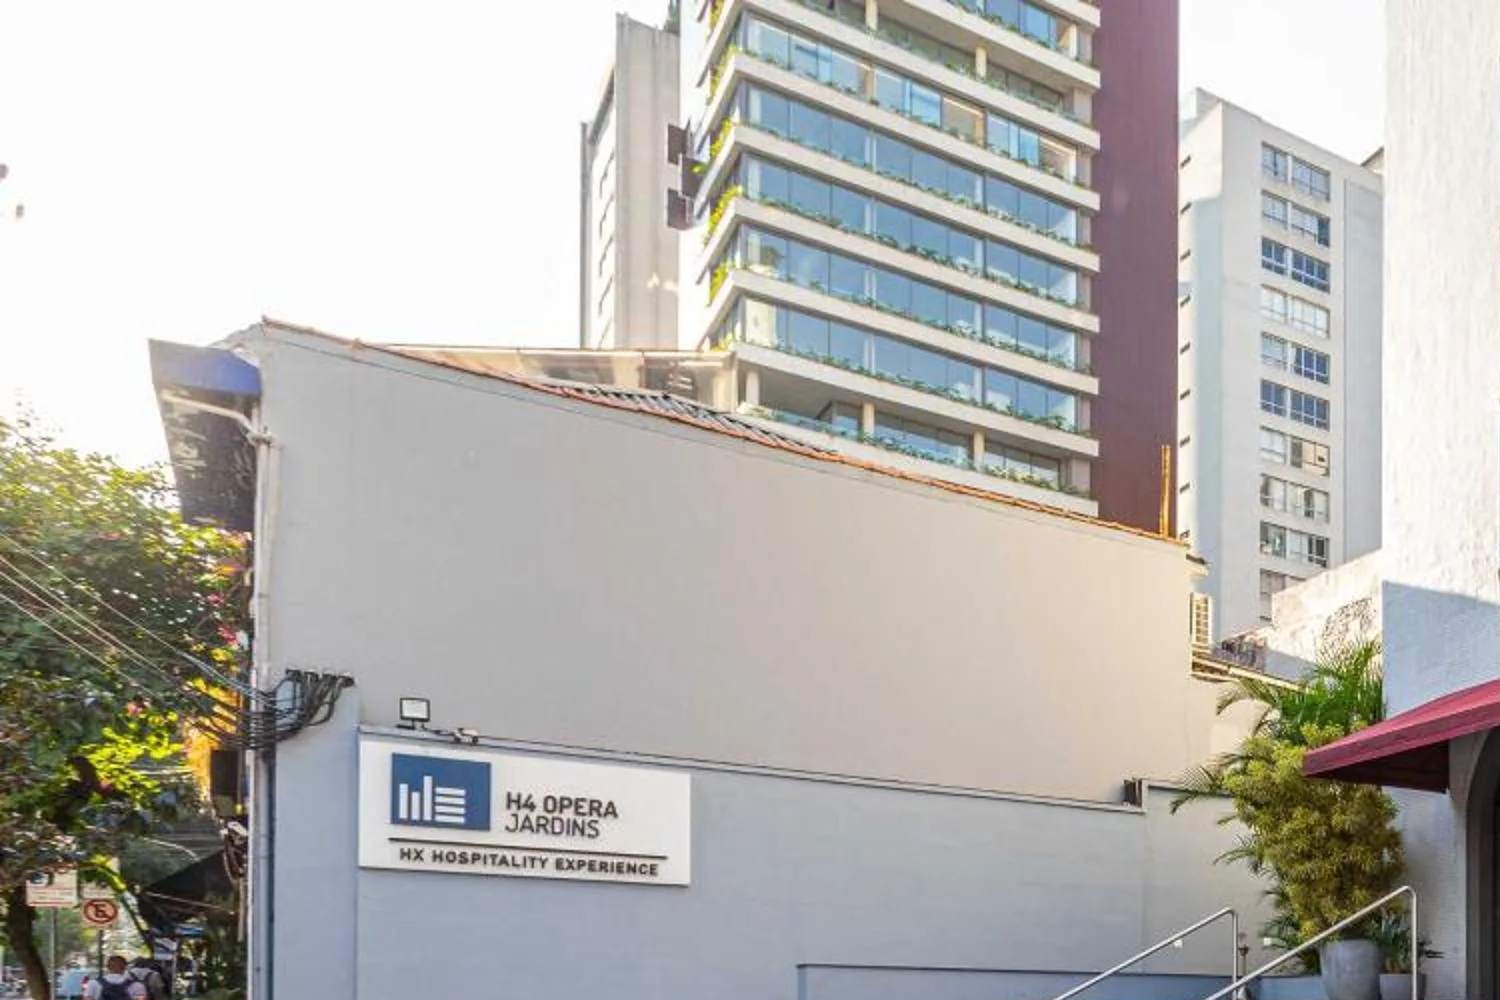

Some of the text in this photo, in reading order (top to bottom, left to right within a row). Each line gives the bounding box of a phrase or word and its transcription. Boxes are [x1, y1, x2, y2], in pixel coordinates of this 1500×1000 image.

[505, 791, 618, 819] H4 OPERA
[505, 813, 599, 838] JARDINS
[399, 848, 658, 876] HX HOSPITALITY EXPERIENCE
